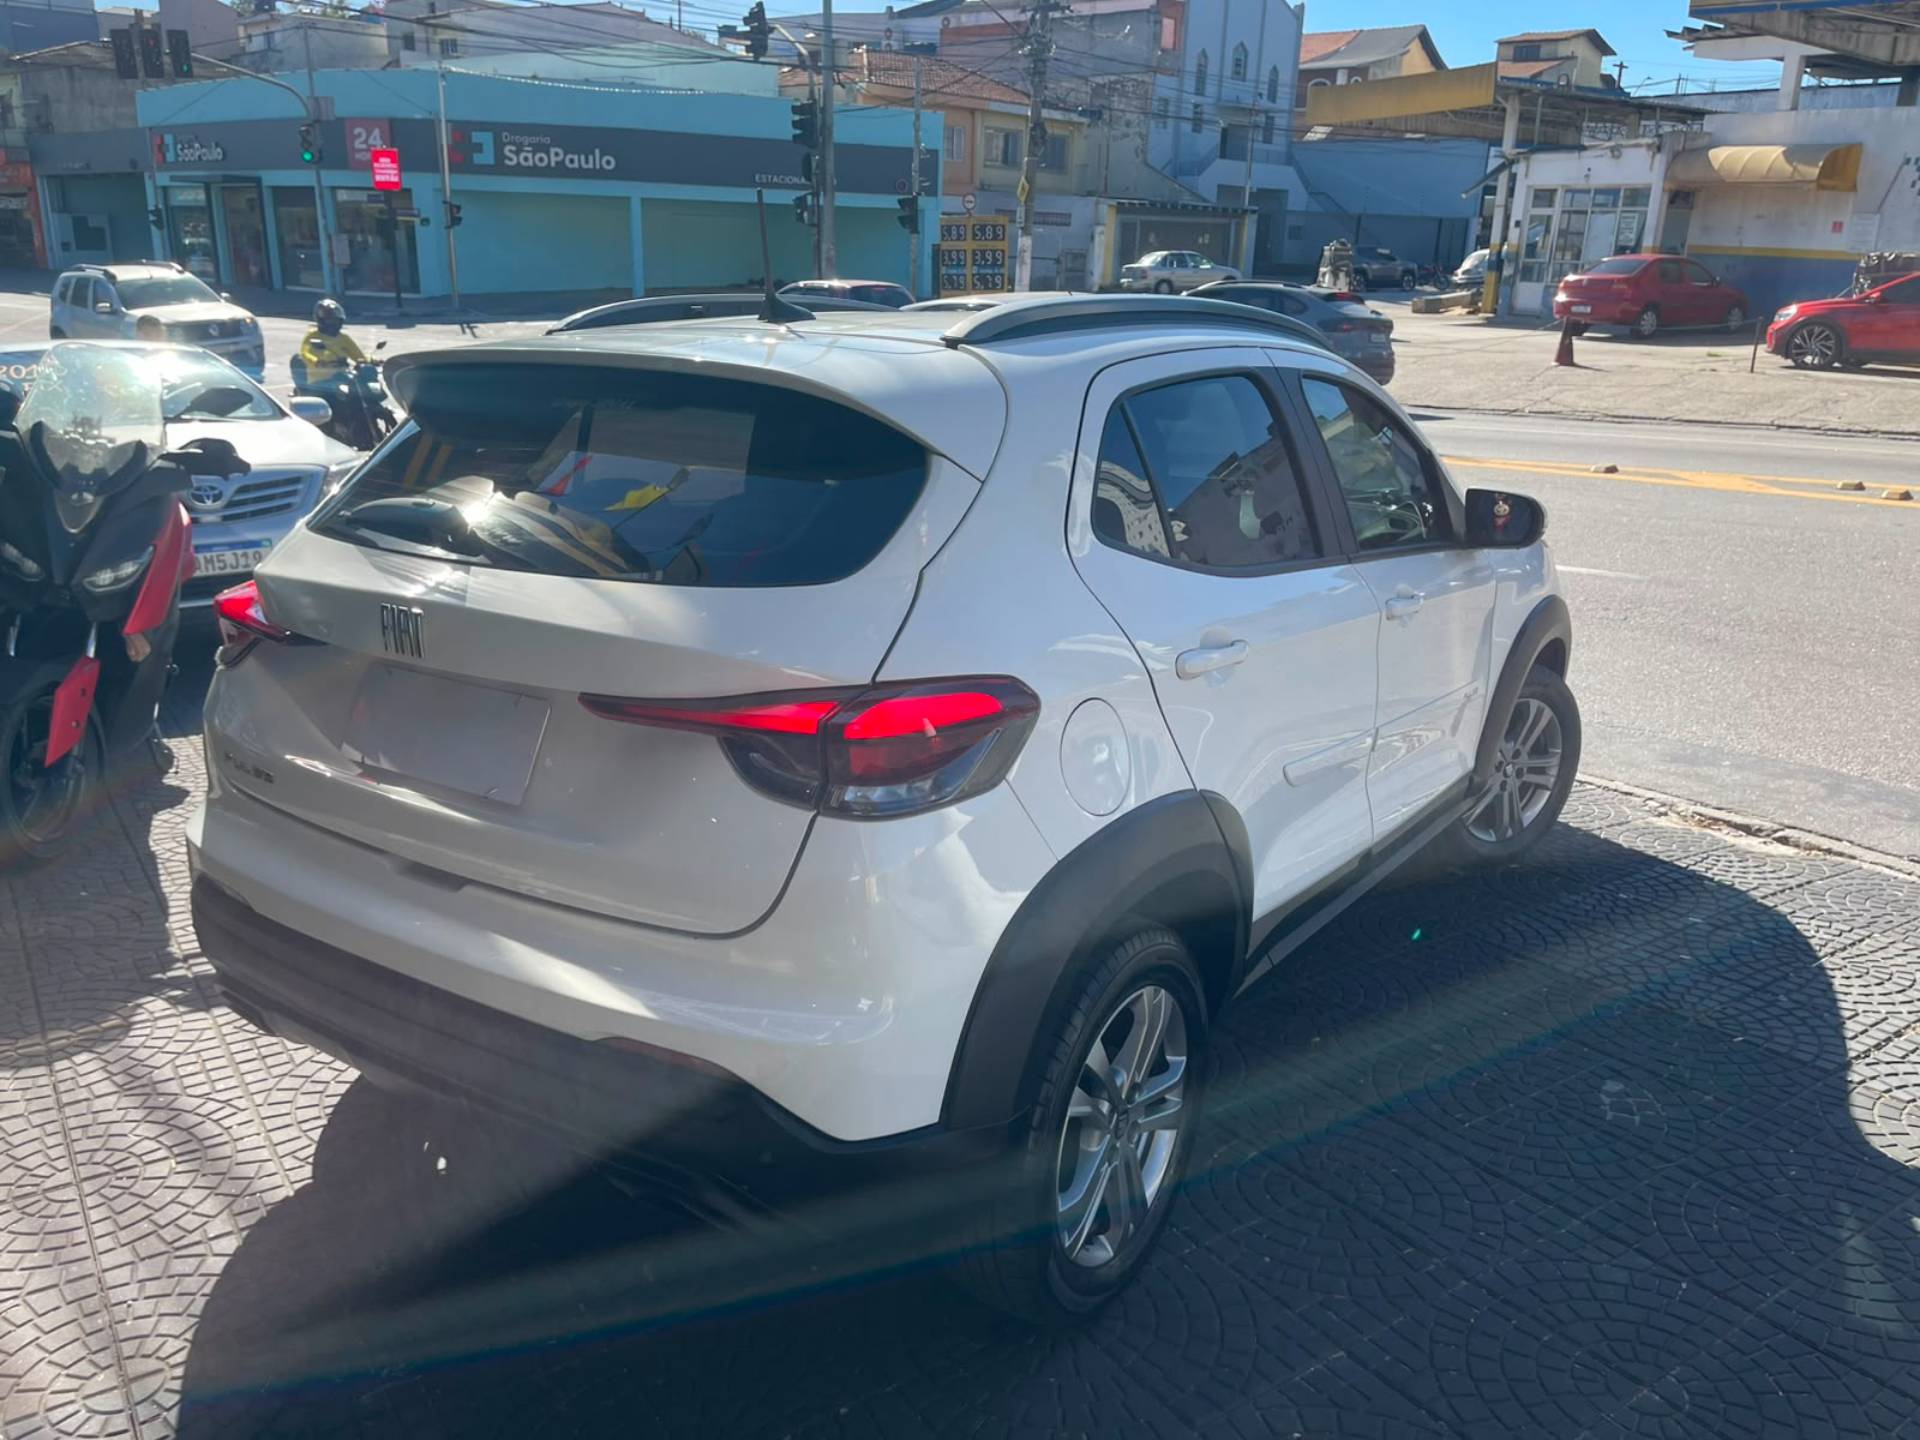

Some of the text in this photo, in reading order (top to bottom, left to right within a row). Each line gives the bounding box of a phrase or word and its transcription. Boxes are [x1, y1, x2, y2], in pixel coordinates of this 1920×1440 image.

[353, 127, 384, 149] 24
[502, 131, 551, 145] Drogaria
[503, 145, 616, 170] SãoPaulo
[974, 225, 1004, 241] 5,89
[381, 602, 425, 659] FIAT
